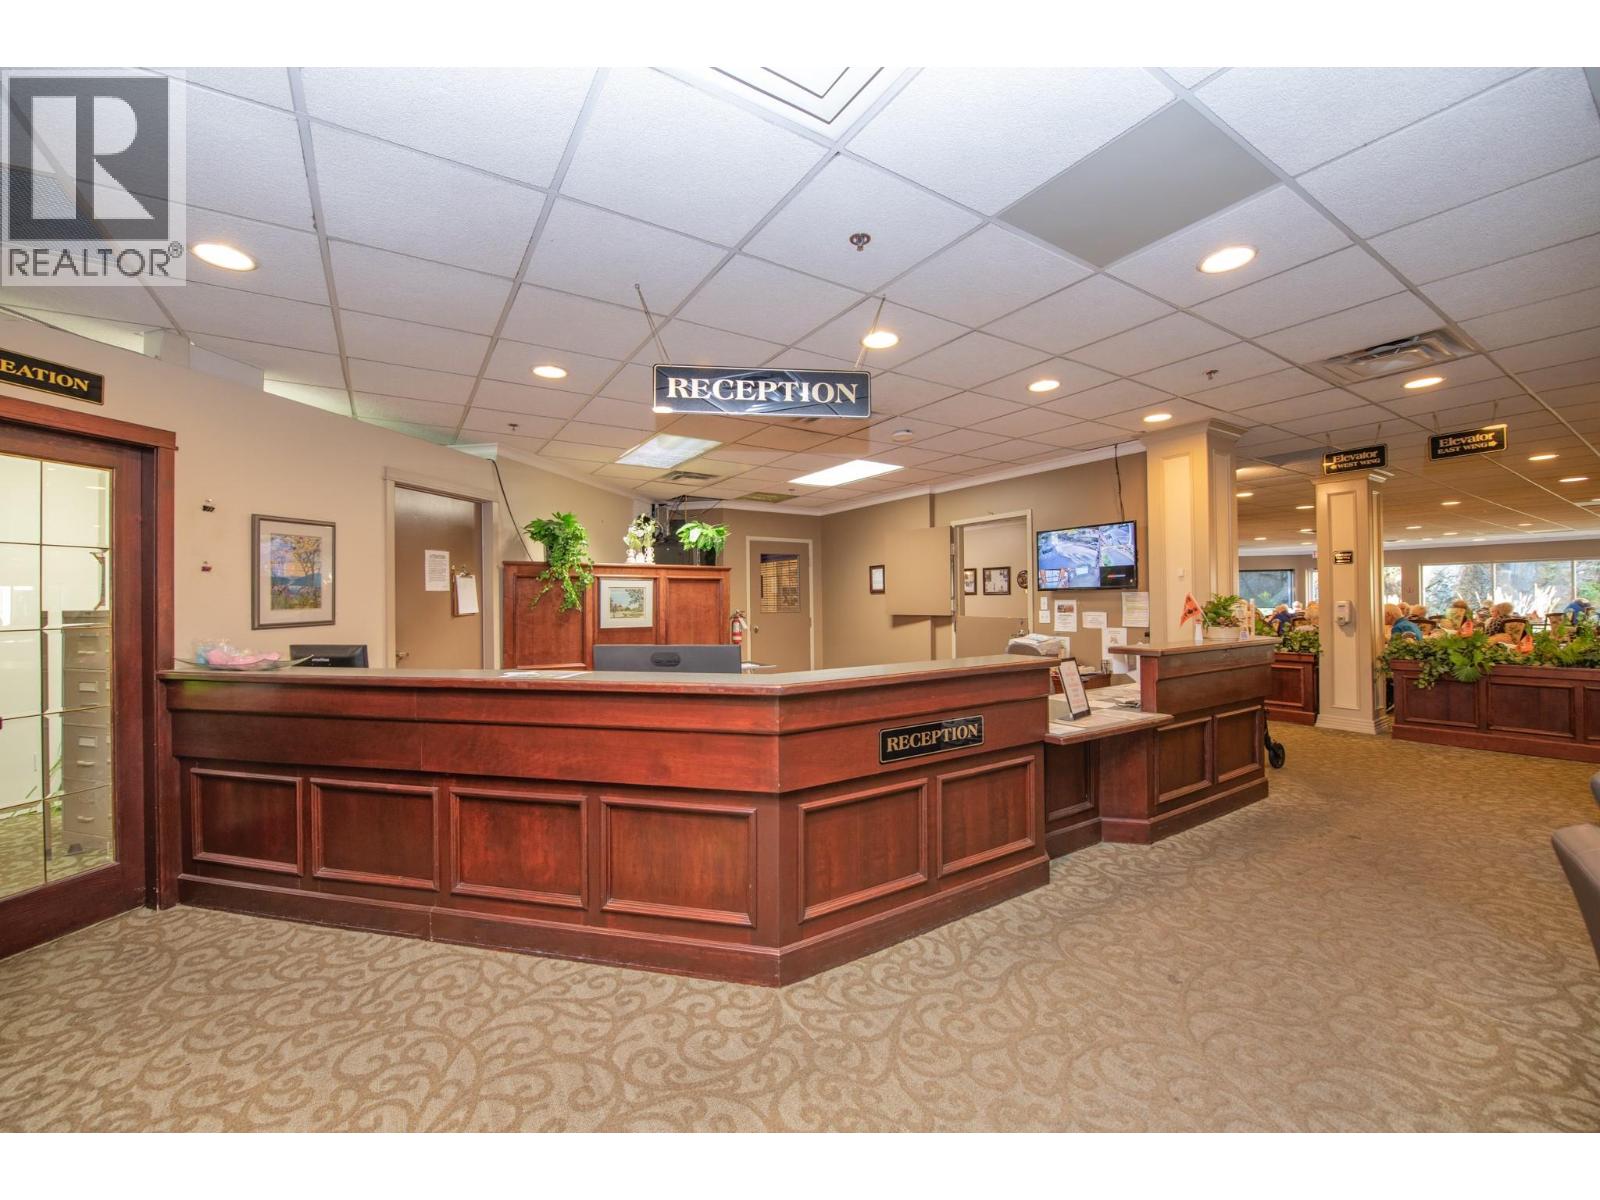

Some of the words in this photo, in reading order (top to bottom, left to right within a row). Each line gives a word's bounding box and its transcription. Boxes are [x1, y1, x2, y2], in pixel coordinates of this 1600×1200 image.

[0, 358, 90, 392] EATION
[667, 377, 858, 404] RECEPTION
[1437, 446, 1461, 455] EAST
[1463, 441, 1488, 450] WING
[1440, 432, 1495, 447] Elevator
[1333, 450, 1378, 463] Elevator
[886, 723, 978, 752] RECEPTION
